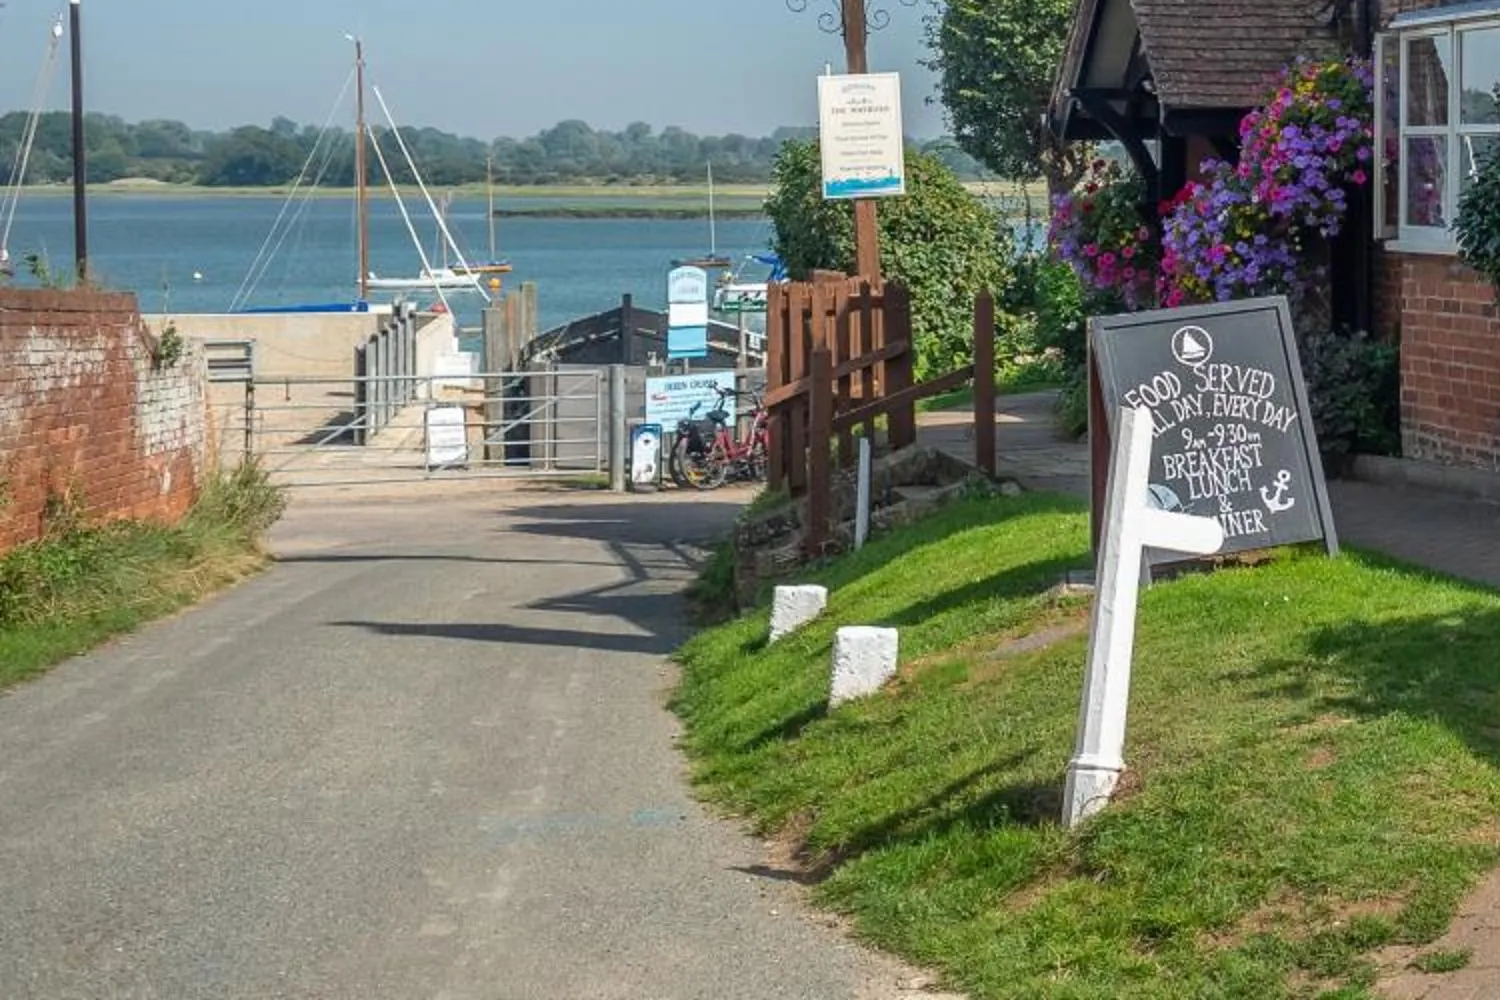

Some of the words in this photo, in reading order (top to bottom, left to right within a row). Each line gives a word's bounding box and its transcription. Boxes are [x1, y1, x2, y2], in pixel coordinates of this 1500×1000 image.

[1124, 371, 1181, 409] FOOD
[1193, 363, 1275, 399] SERVED
[1213, 393, 1261, 422] EVERY
[1261, 401, 1297, 433] DAY
[1162, 443, 1263, 480] BREAKFAST
[1189, 469, 1253, 499] LUNCH
[1219, 493, 1232, 512] &
